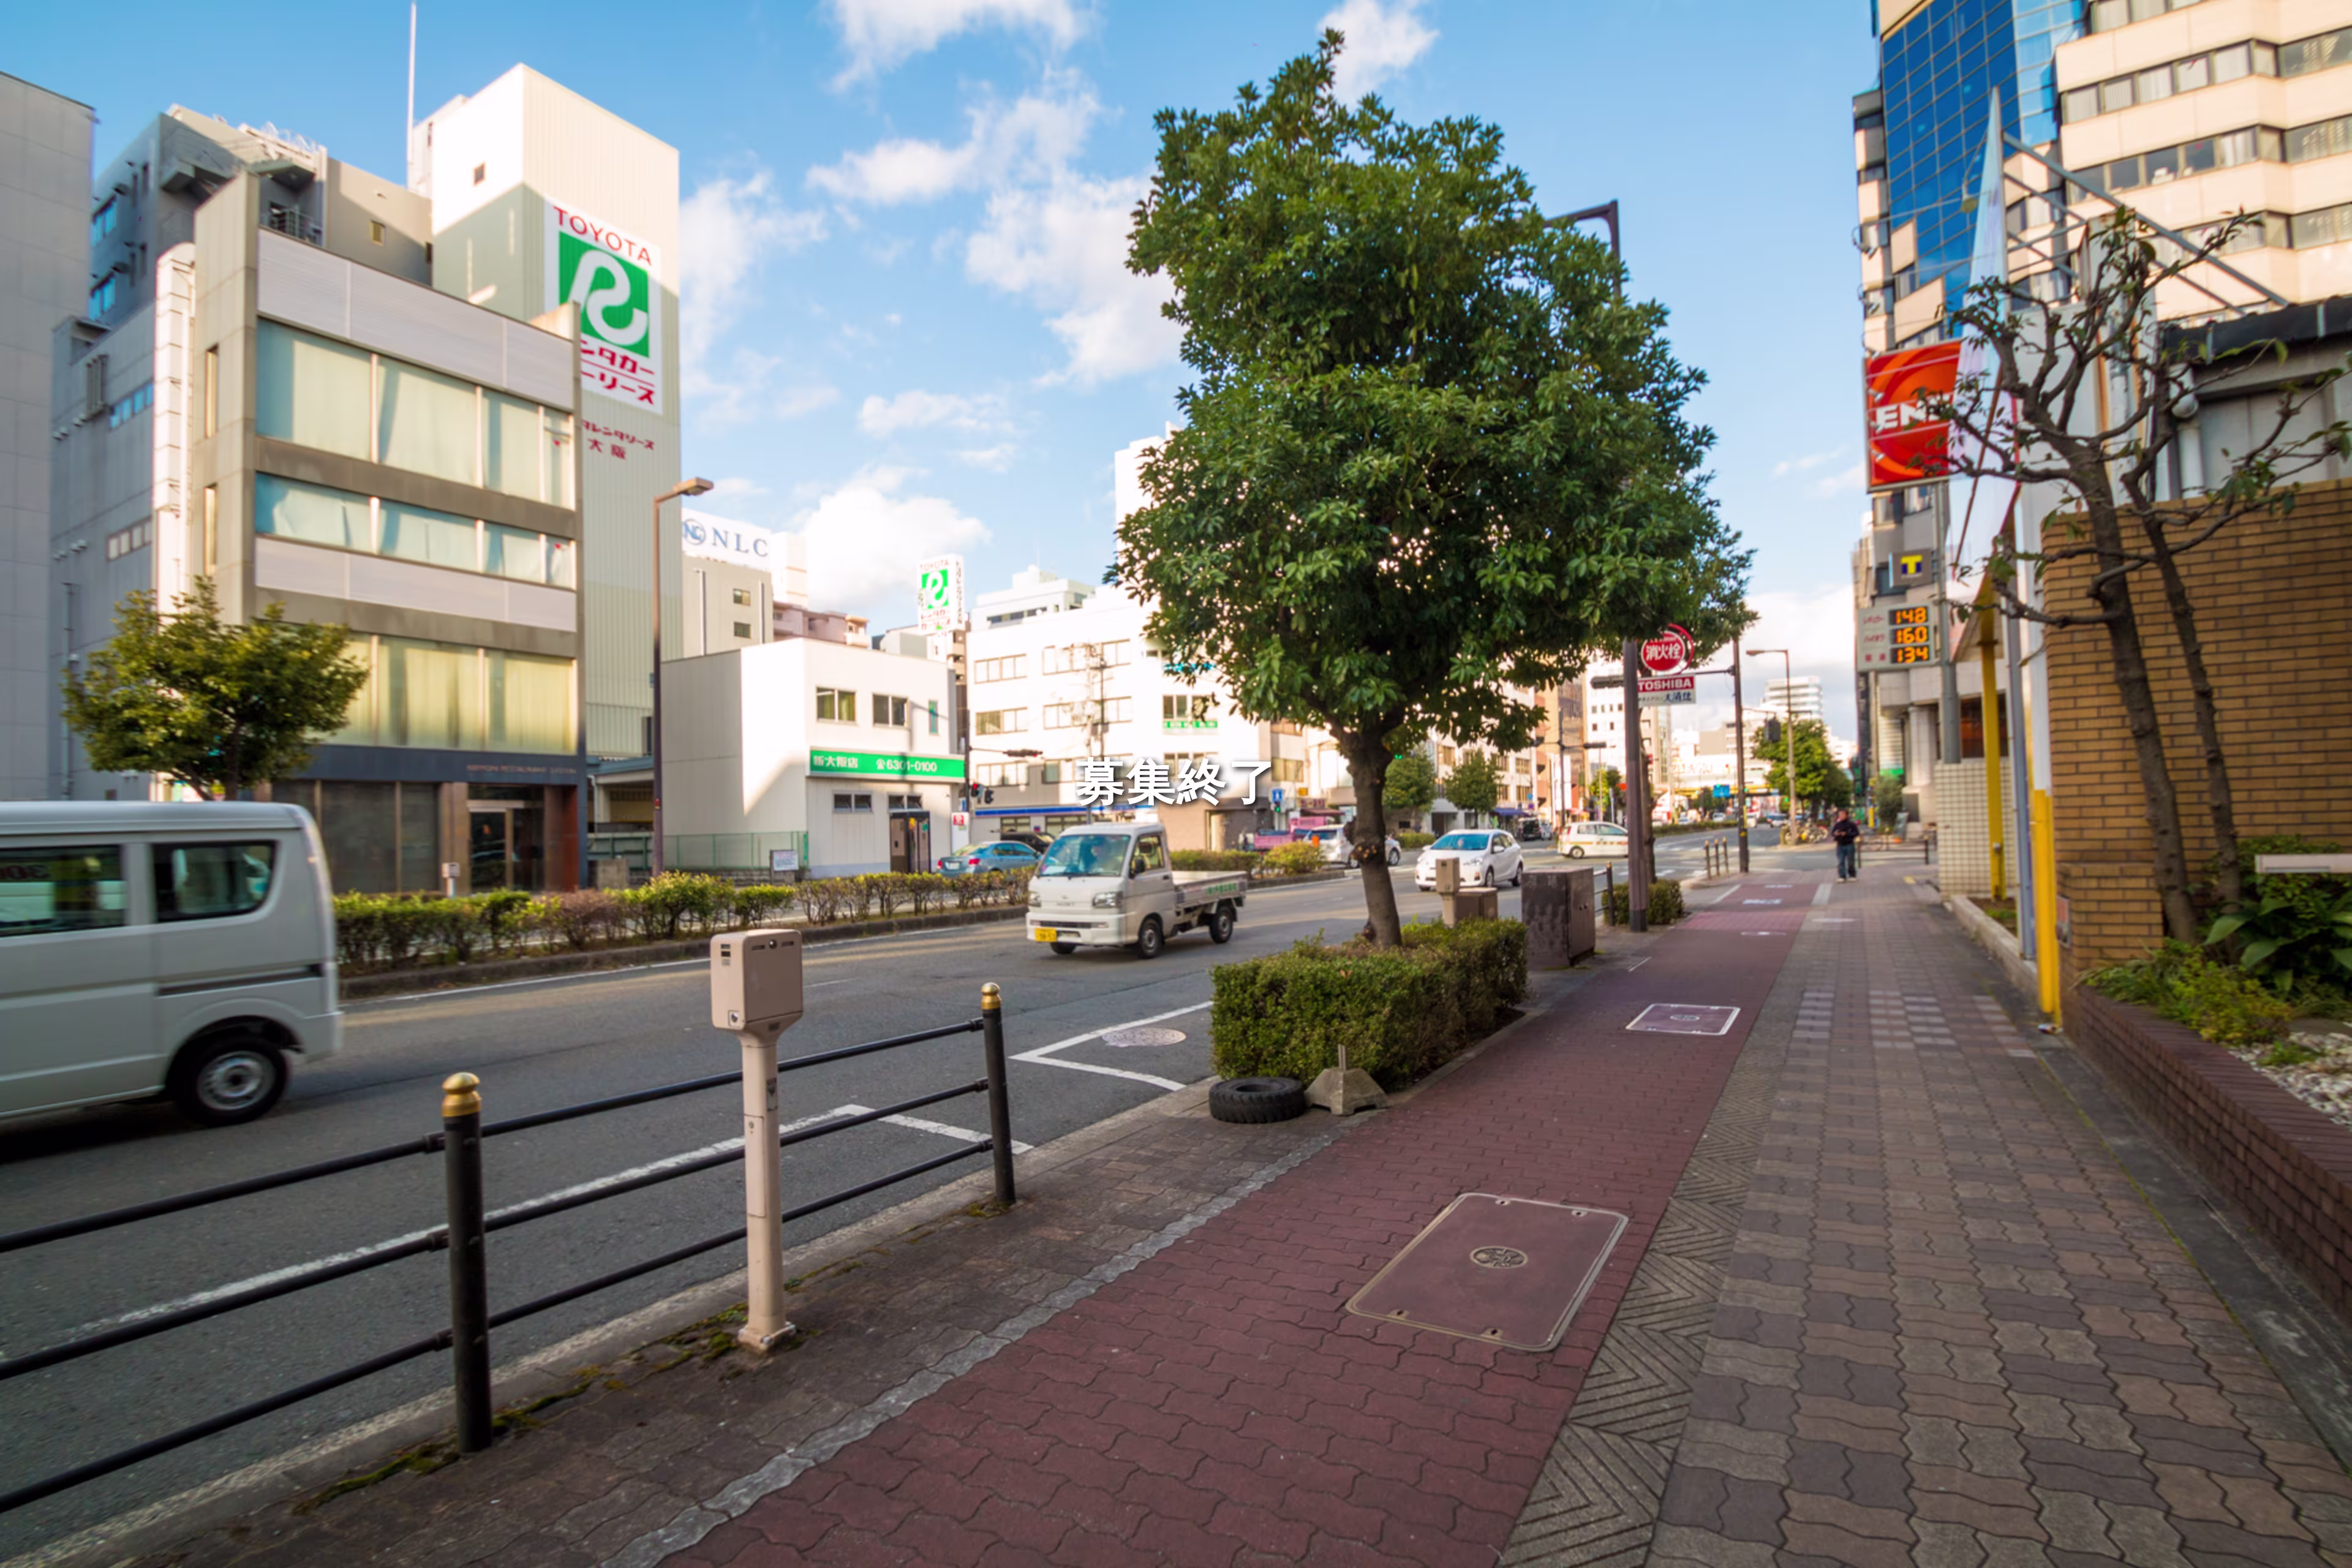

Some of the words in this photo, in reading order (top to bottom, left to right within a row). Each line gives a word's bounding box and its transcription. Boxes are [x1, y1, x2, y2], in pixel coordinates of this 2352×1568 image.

[554, 206, 652, 266] TOYOTA
[587, 437, 626, 461] 大阪
[711, 526, 768, 557] NLC
[920, 559, 949, 571] TOYOTA
[1896, 606, 1927, 625] 148
[1896, 625, 1928, 644] 160
[1646, 643, 1681, 661] 消火栓
[1897, 646, 1929, 663] 134
[1638, 678, 1692, 691] TOSHIBA
[813, 755, 858, 769] 新大阪店
